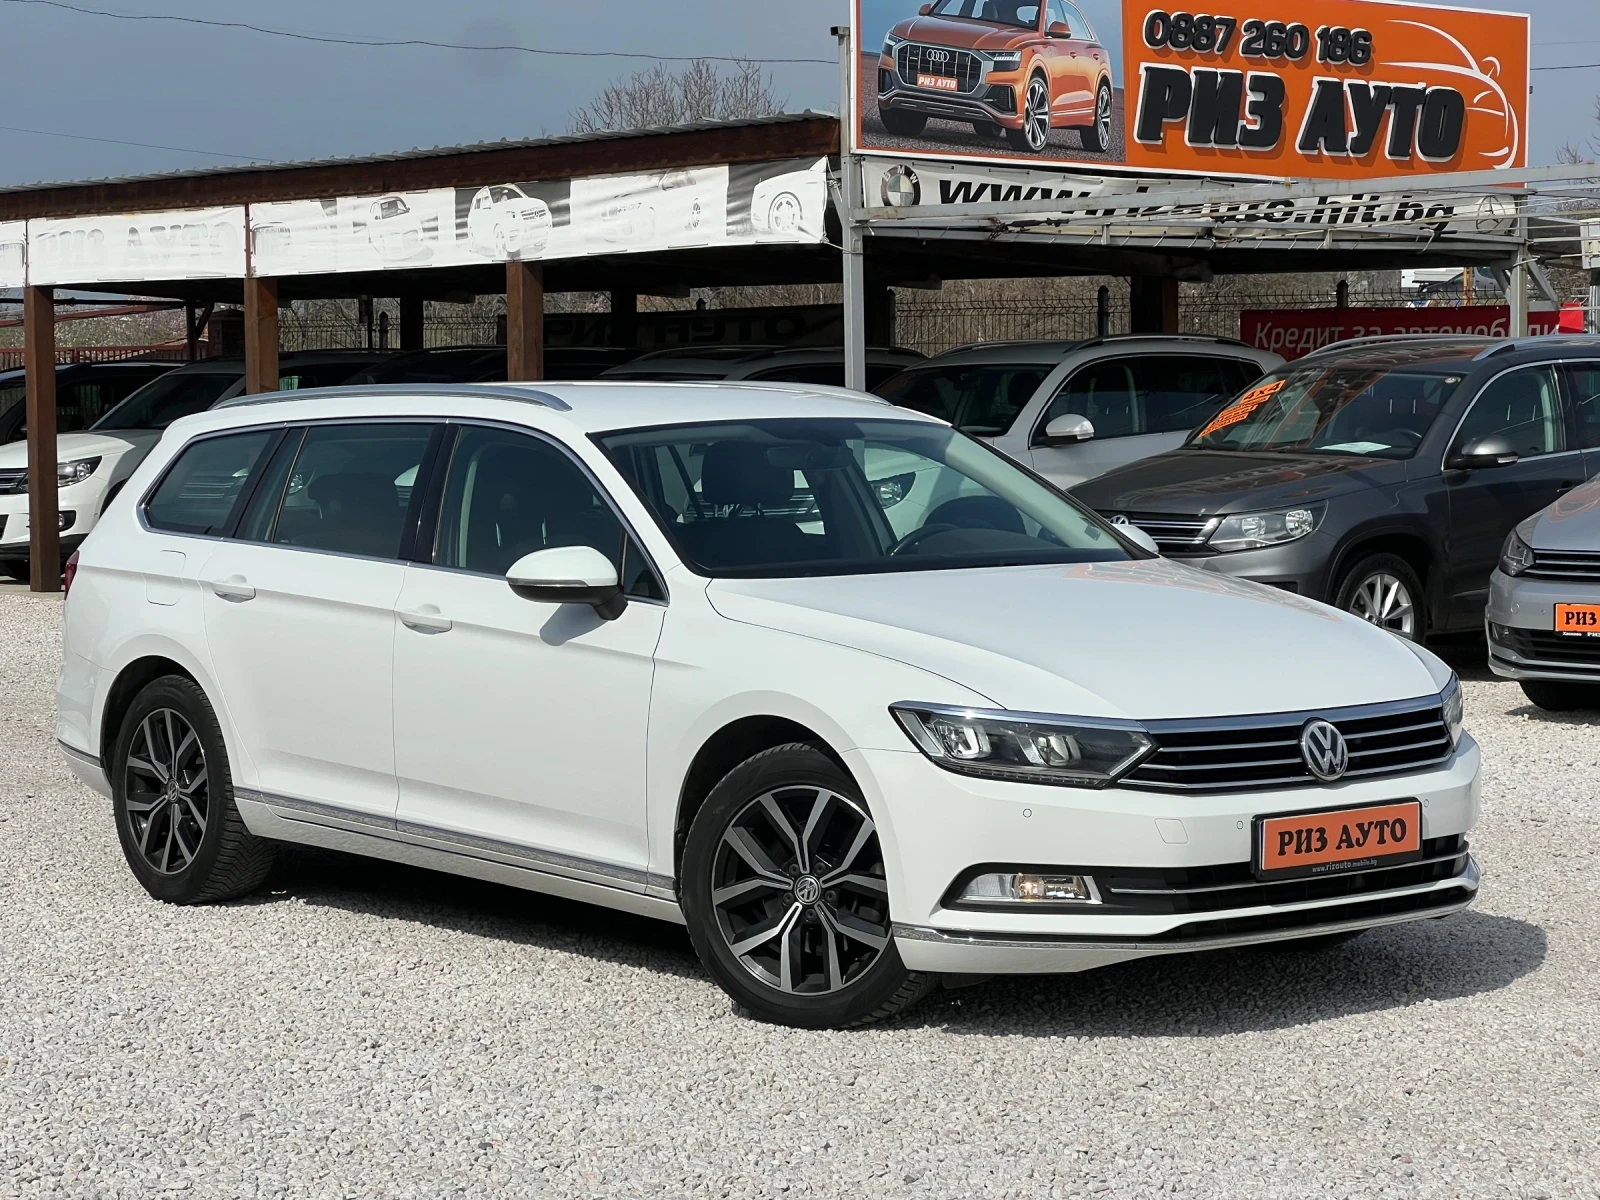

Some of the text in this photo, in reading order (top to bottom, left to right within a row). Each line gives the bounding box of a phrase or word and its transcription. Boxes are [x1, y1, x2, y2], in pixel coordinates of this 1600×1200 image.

[1143, 9, 1372, 66] 0887 260 186
[918, 77, 957, 89] РИЗ АУТО
[1135, 63, 1465, 163] РИЗ АУТО
[1254, 322, 1344, 353] Кредит
[1565, 611, 1597, 626] РИЗ
[1277, 818, 1407, 857] РИЗ АУТО
